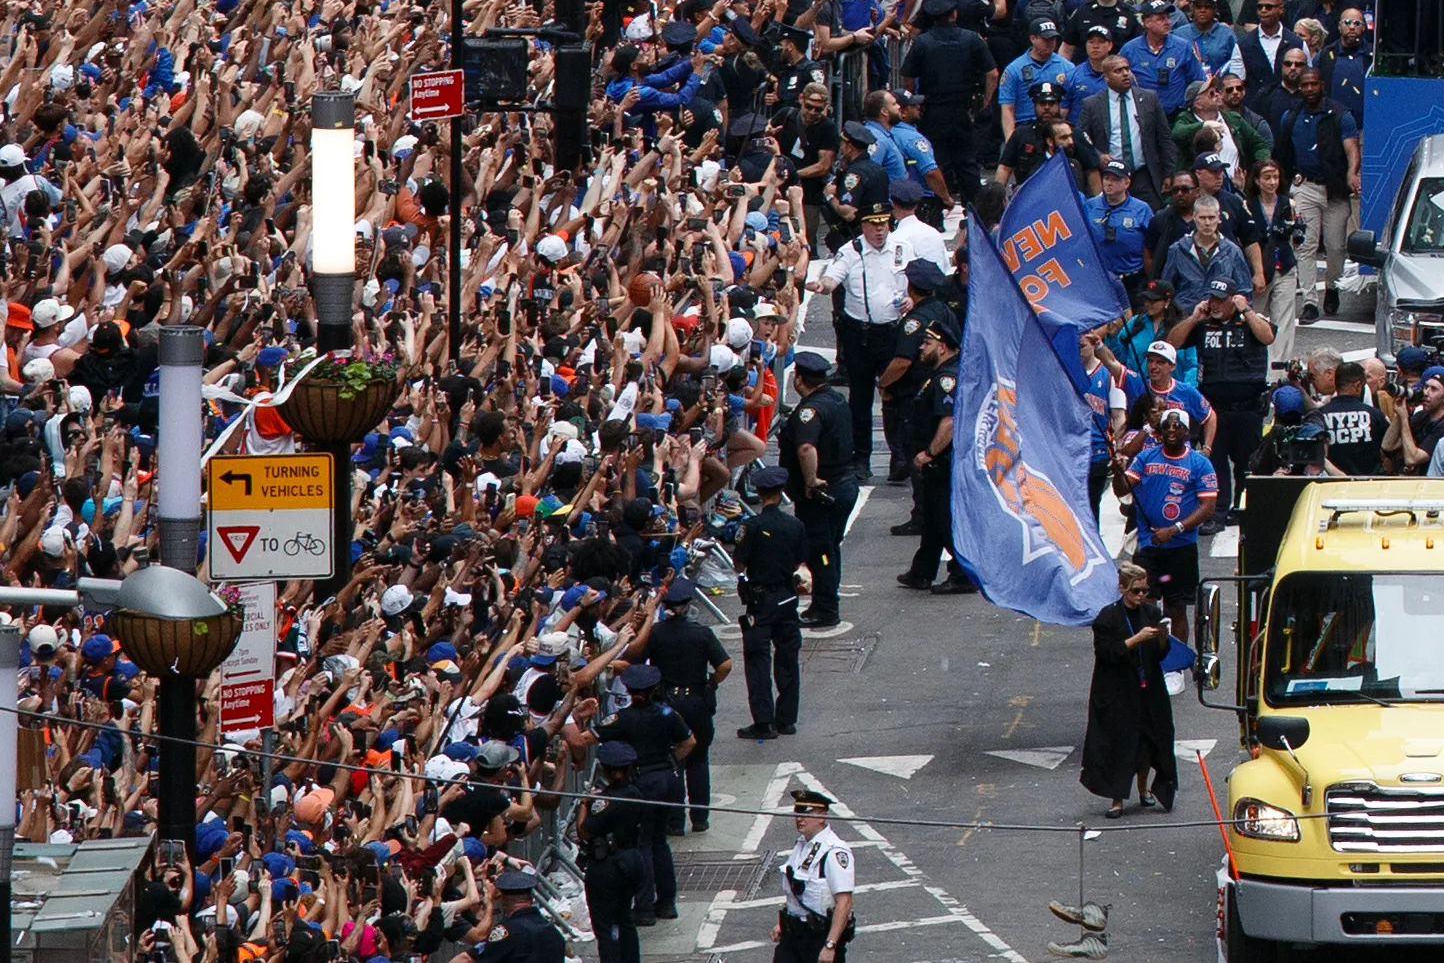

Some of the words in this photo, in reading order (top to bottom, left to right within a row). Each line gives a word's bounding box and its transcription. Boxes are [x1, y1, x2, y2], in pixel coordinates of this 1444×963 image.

[413, 80, 422, 88] NO
[423, 76, 455, 87] STOPPING
[413, 89, 440, 99] Anytime
[1322, 411, 1370, 429] NYPD
[263, 466, 320, 482] TURNING
[1145, 463, 1164, 475] NEW
[1165, 464, 1192, 481] YORK
[261, 483, 323, 499] VEHICLES
[260, 538, 280, 552] TO
[255, 621, 270, 630] ONLY
[223, 688, 233, 698] NO
[234, 684, 266, 697] STOPPING
[223, 698, 250, 710] Anytime
